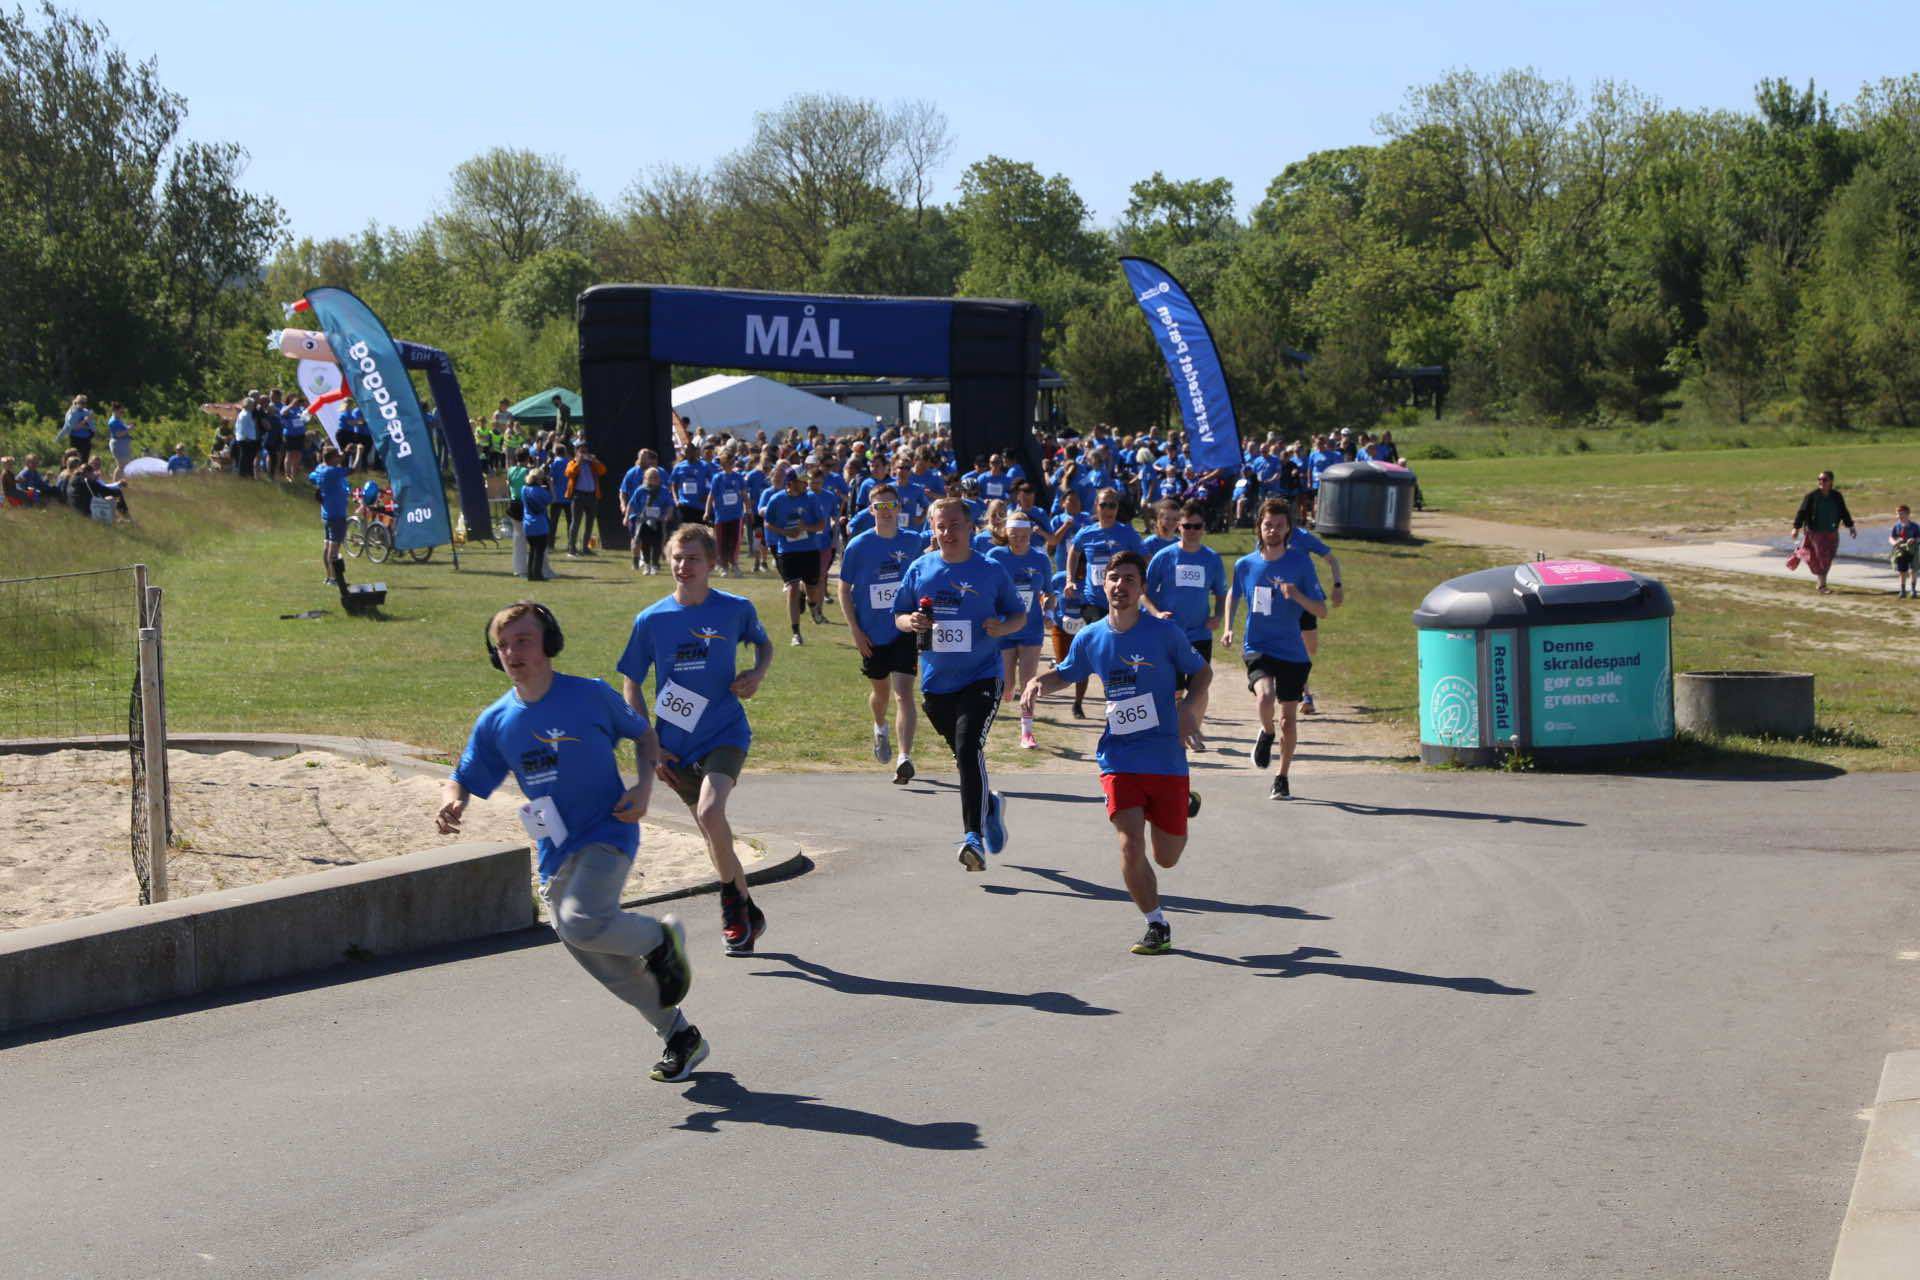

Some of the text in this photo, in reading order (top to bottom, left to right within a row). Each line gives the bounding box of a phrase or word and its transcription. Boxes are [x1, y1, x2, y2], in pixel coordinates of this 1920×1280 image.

[745, 304, 855, 359] MÅL
[1183, 571, 1201, 581] 359
[937, 629, 963, 643] 363
[1543, 640, 1594, 653] Denne
[1543, 652, 1641, 671] skraldespand
[1494, 645, 1510, 729] Restaffald
[1543, 671, 1623, 692] gør os alle
[661, 691, 694, 717] 366
[1543, 692, 1620, 710] grønnere.
[1115, 704, 1148, 725] 365
